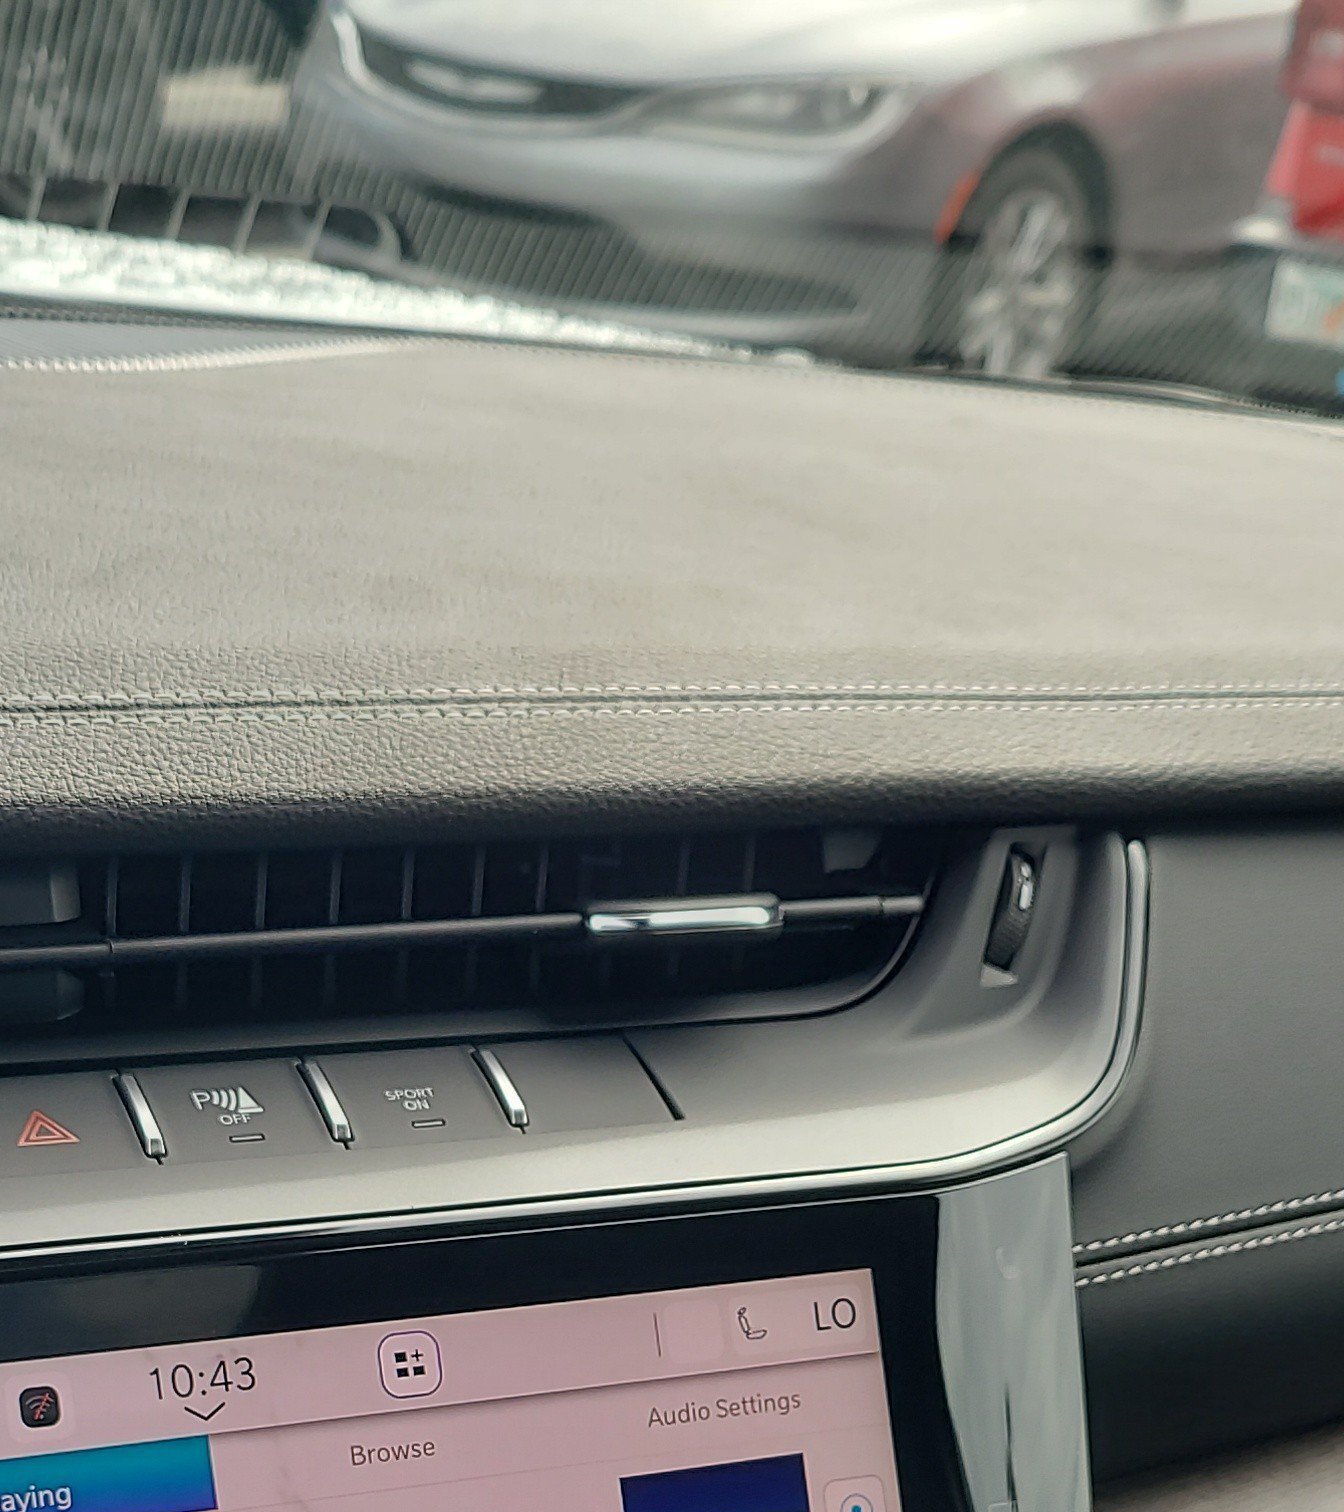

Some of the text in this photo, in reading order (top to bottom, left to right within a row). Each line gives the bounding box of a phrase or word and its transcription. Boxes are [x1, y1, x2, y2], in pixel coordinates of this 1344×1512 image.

[384, 1087, 435, 1103] SPORT
[401, 1097, 431, 1111] ON
[219, 1112, 252, 1127] OFF
[813, 1297, 857, 1333] LO
[148, 1355, 256, 1400] 10:43
[647, 1390, 801, 1429] Audio Settings
[350, 1437, 436, 1467] Browse
